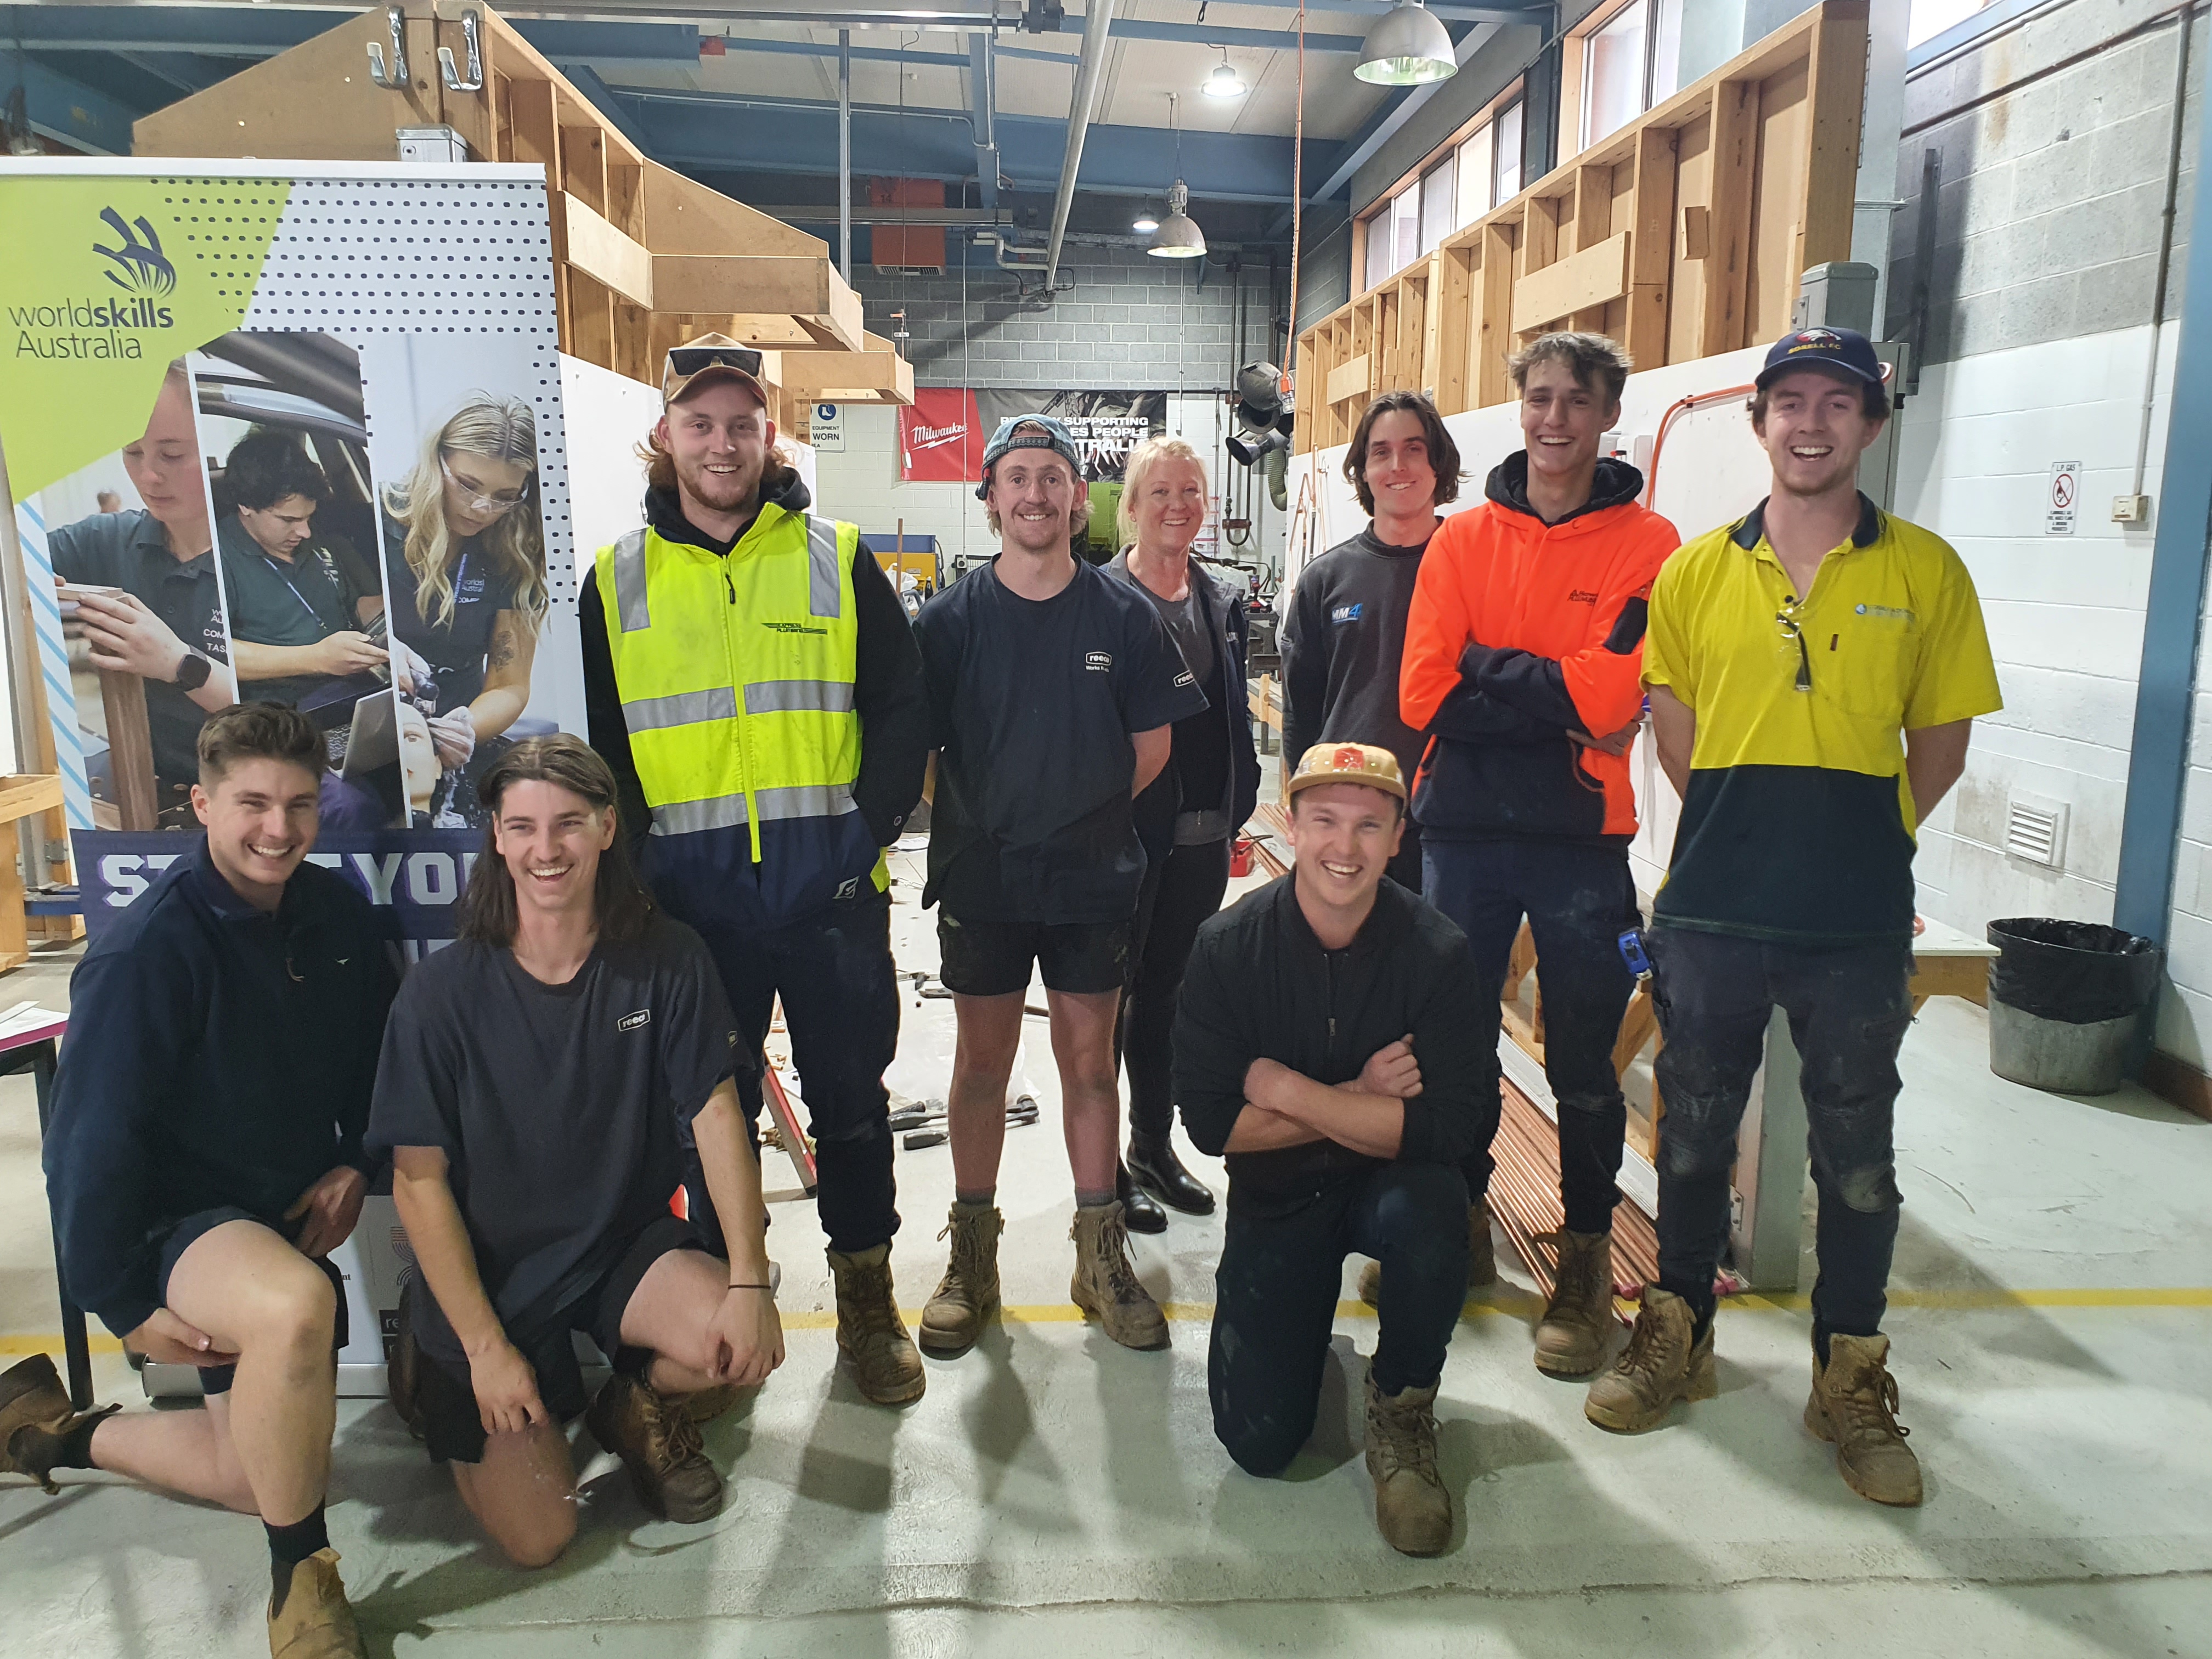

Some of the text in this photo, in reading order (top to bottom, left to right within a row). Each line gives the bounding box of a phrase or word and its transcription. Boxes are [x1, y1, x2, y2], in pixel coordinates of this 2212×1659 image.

[8, 297, 174, 328] worldskills
[16, 329, 143, 359] Australia
[1063, 417, 1149, 426] SUPPORTING
[1092, 427, 1148, 437] PEOPLE
